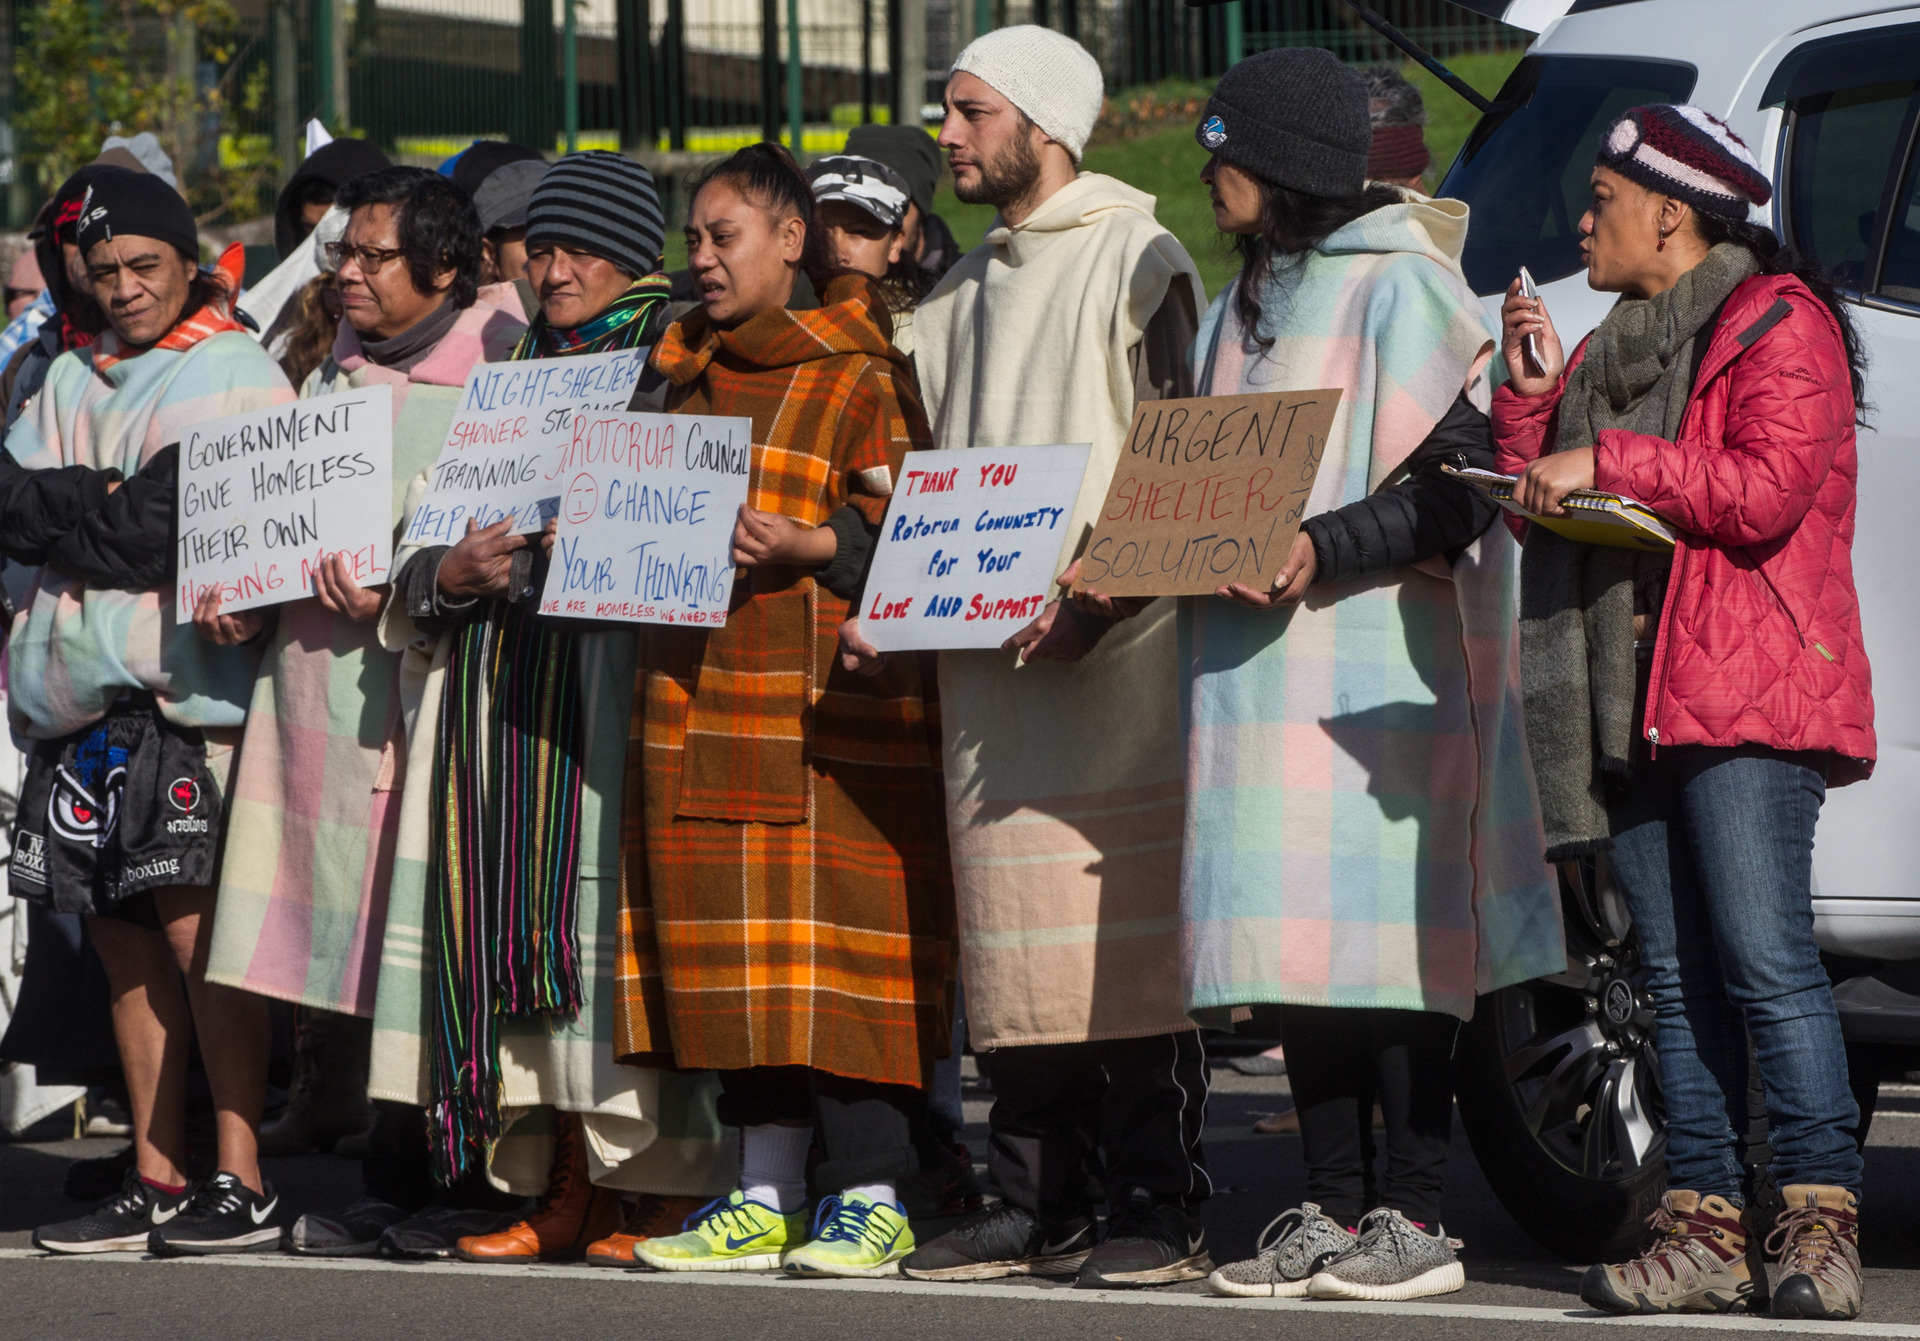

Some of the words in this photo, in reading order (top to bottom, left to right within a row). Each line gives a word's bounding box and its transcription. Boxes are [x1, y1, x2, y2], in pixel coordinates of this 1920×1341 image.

[188, 400, 367, 471] GOVERNMENT
[448, 416, 530, 451] SHOWER
[568, 414, 675, 473] ROTORUA
[1132, 400, 1318, 466] URGENT
[183, 477, 233, 518] GIVE
[251, 452, 376, 502] HOMELESS
[434, 454, 542, 492] TRAINNING
[906, 467, 960, 497] THANK
[979, 463, 1018, 488] YOU
[1106, 467, 1284, 523] SHELTER
[407, 504, 467, 542] HELP
[604, 479, 711, 526] CHANGE
[177, 524, 249, 569] THEIR
[263, 498, 318, 549] OWN
[1082, 517, 1278, 584] SOLUTION
[181, 562, 284, 614] HOSING
[626, 540, 728, 609] THINKING
[542, 600, 560, 613] WE
[566, 600, 587, 613] ARE
[595, 602, 656, 618] HOMELESS
[659, 608, 676, 623] WE
[679, 611, 707, 624] NEED
[923, 594, 963, 618] AND
[126, 858, 181, 882] boxing
